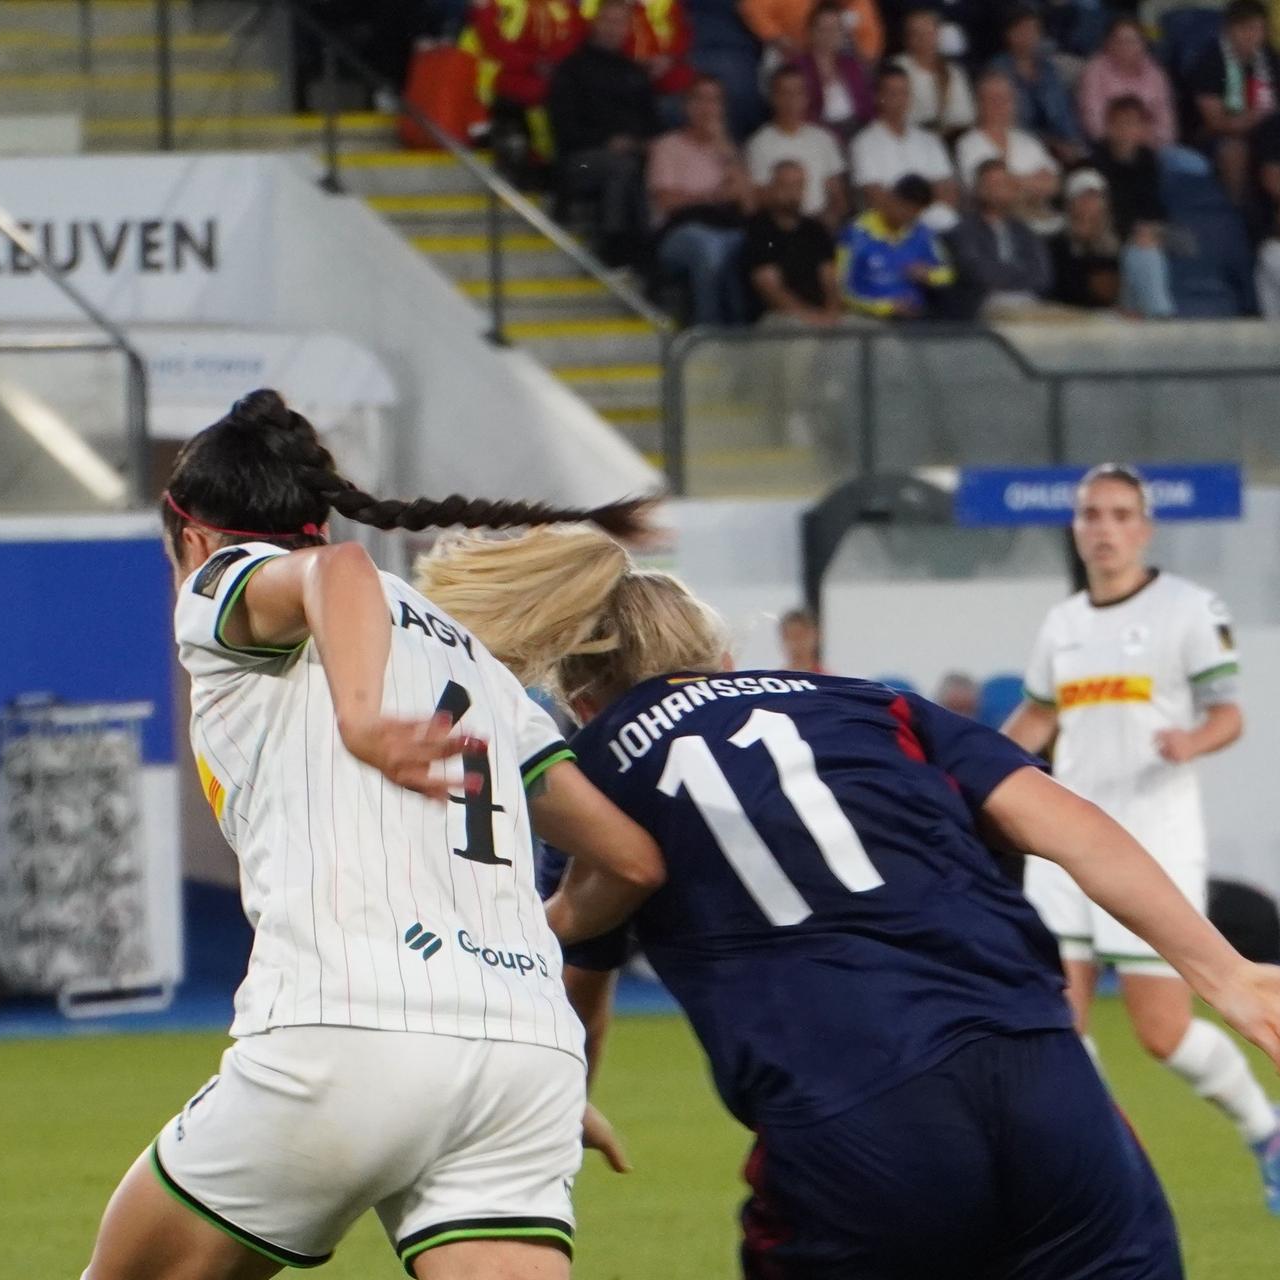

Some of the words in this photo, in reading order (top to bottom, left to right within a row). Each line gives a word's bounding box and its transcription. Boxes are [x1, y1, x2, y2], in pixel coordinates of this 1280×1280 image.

[390, 599, 477, 662] AGY
[608, 677, 818, 774] JOHANSSON
[656, 708, 886, 926] 11
